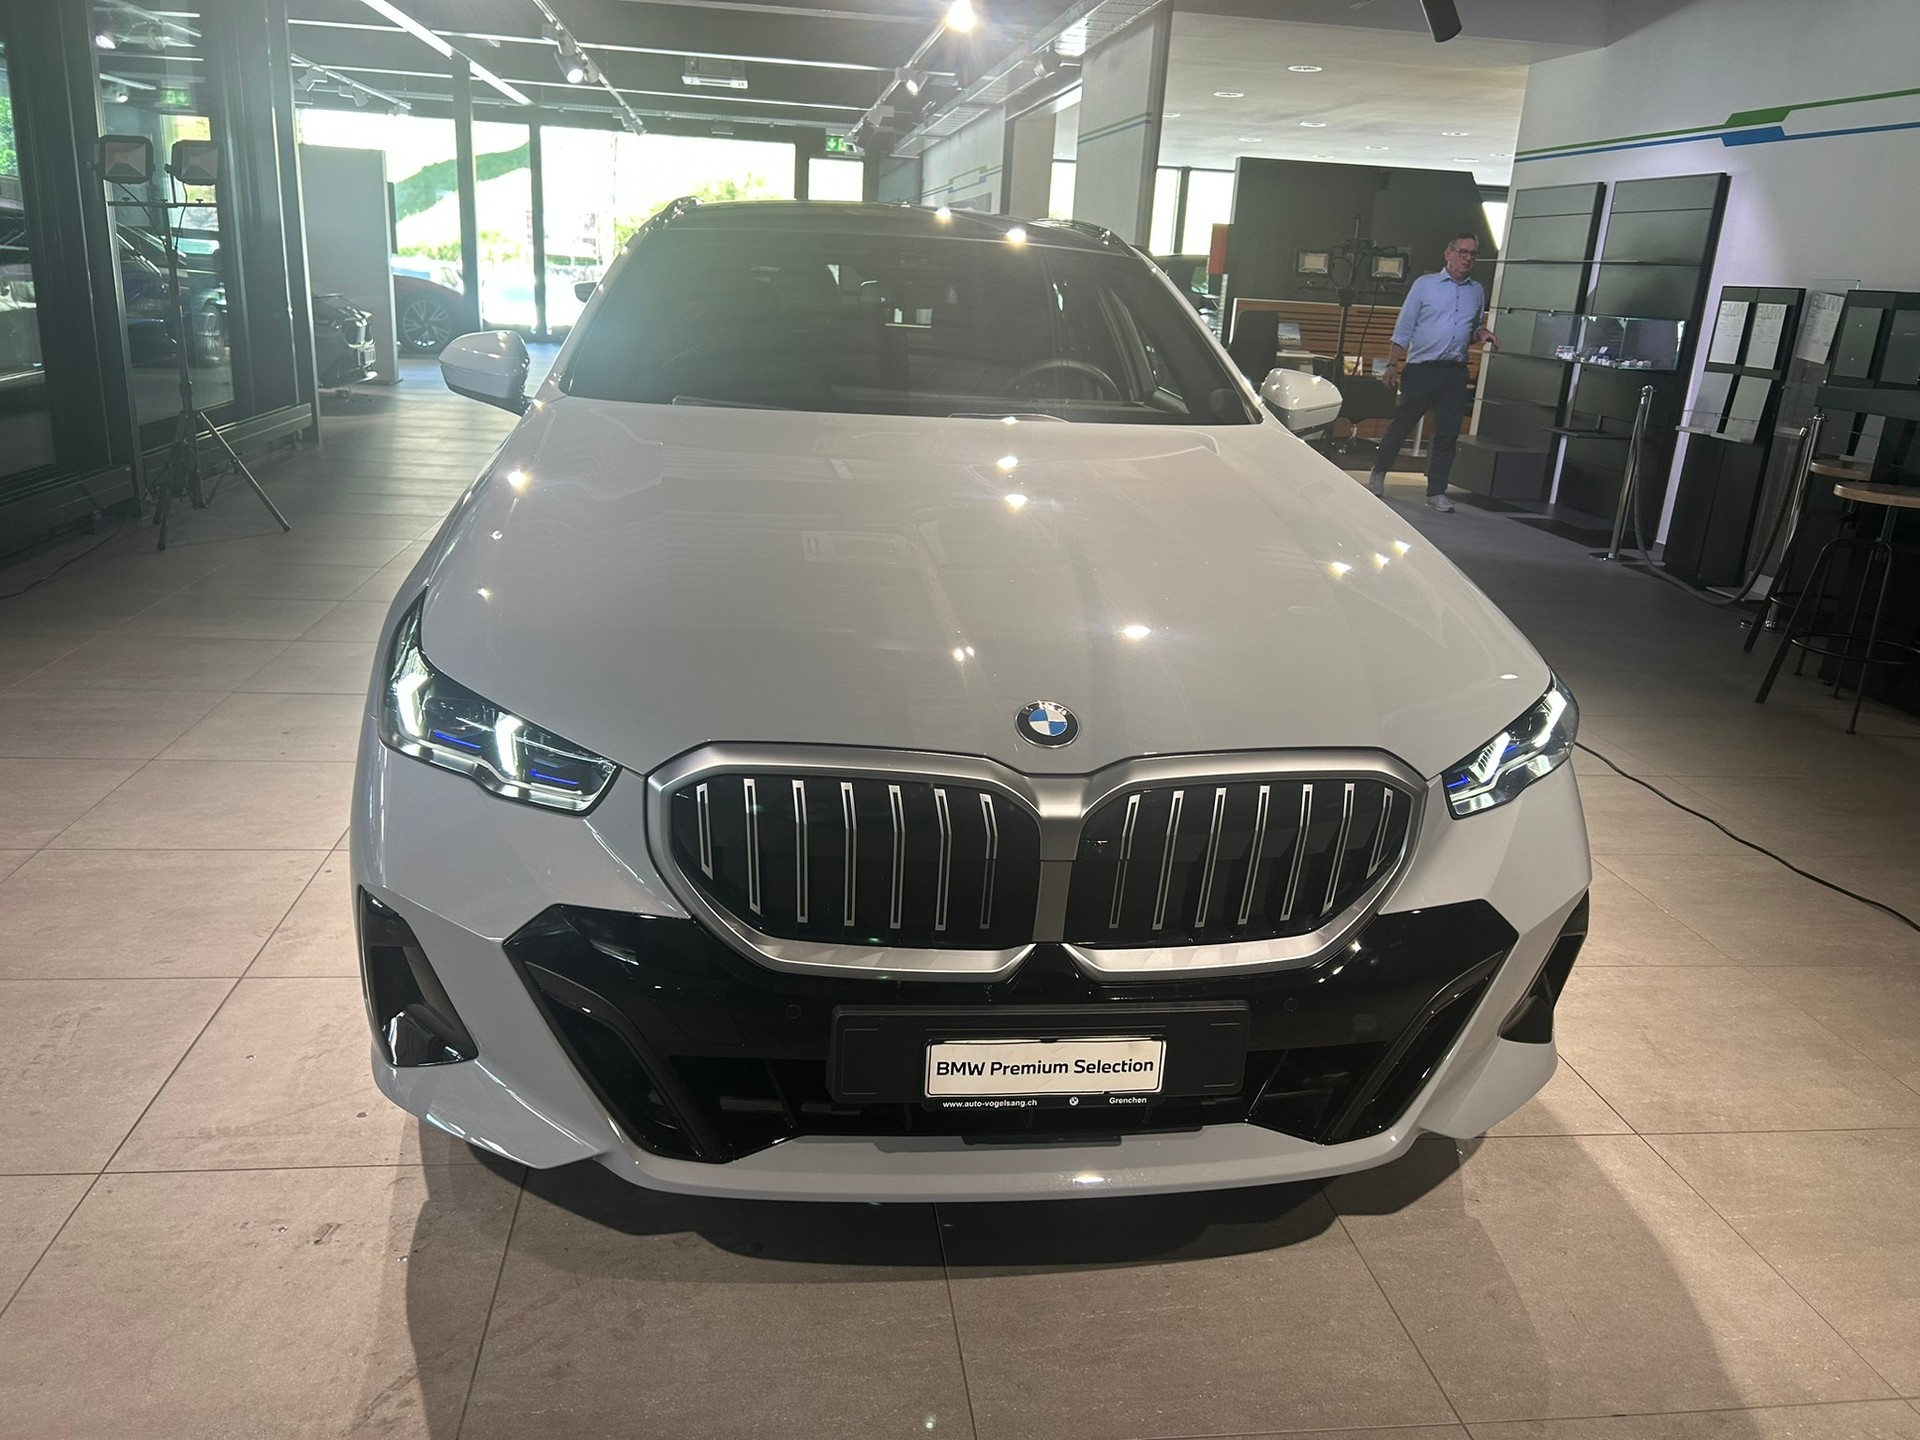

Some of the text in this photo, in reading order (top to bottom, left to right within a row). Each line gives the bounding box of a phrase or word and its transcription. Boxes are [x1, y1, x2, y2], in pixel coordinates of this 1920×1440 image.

[936, 1058, 1154, 1076] BMW Premium Selection
[942, 1099, 1038, 1109] www.auto-vogelsang.ch
[1108, 1096, 1147, 1105] Grenchen
